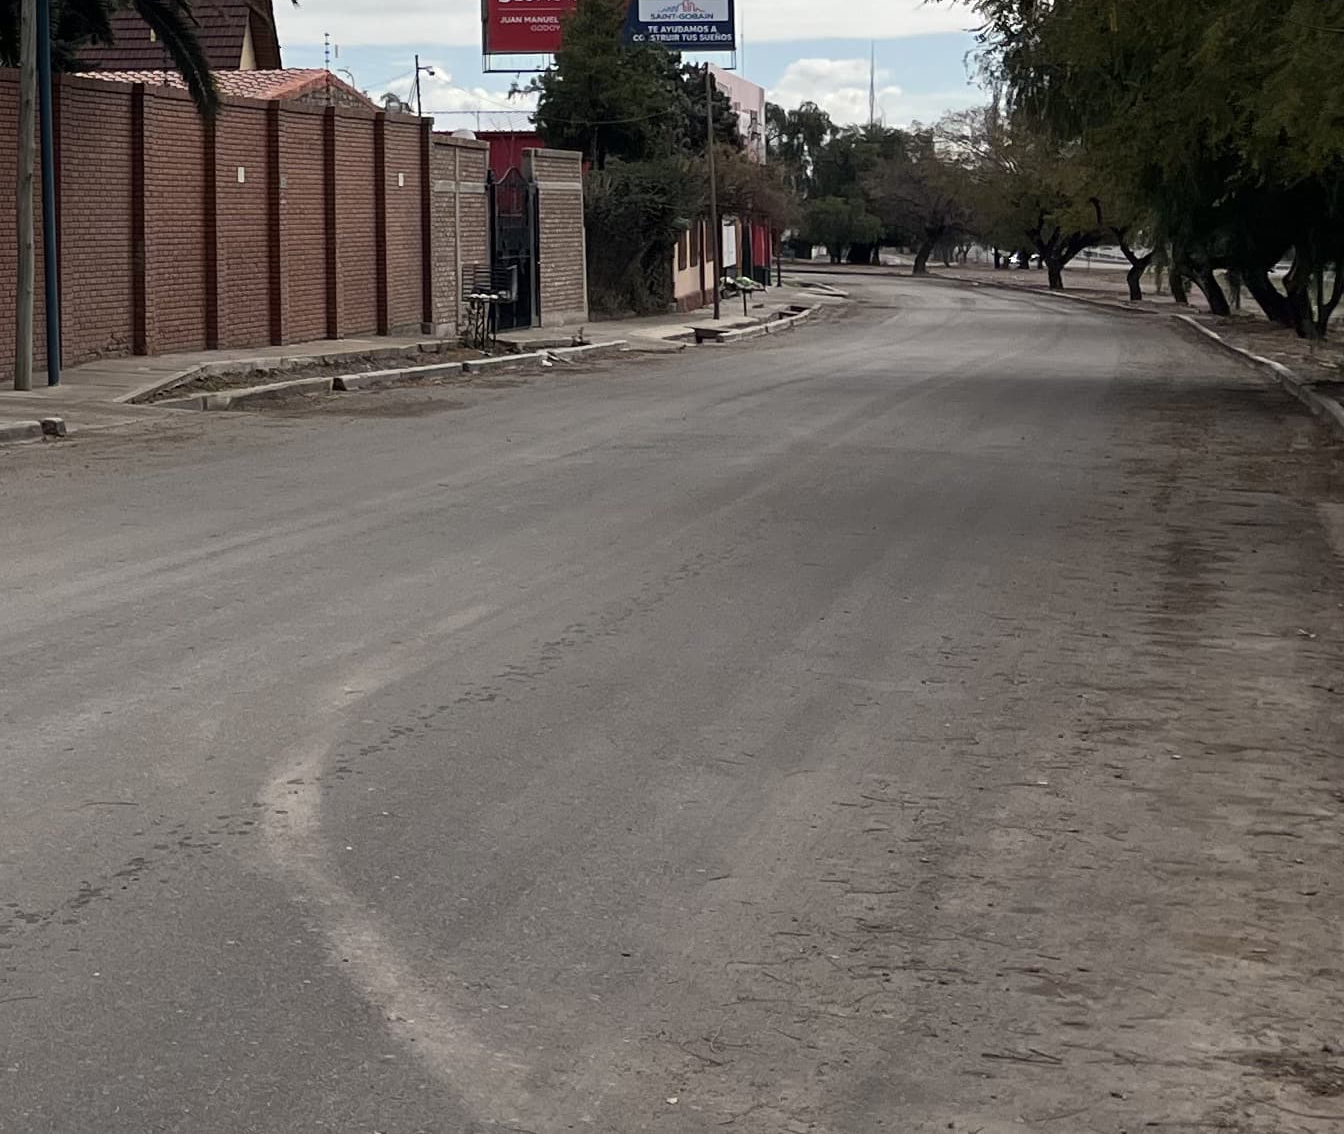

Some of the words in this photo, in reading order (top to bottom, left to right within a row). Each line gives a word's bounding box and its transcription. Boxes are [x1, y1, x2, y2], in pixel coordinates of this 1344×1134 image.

[500, 16, 523, 24] JUAN
[524, 16, 560, 24] MANUEL
[530, 24, 561, 32] GODOY
[647, 25, 659, 33] TE
[660, 25, 709, 33] AYUDAMOS
[710, 25, 717, 33] A
[633, 33, 680, 42] COSTRUIR
[681, 33, 698, 41] TUS
[699, 32, 732, 41] SUEÑOS
